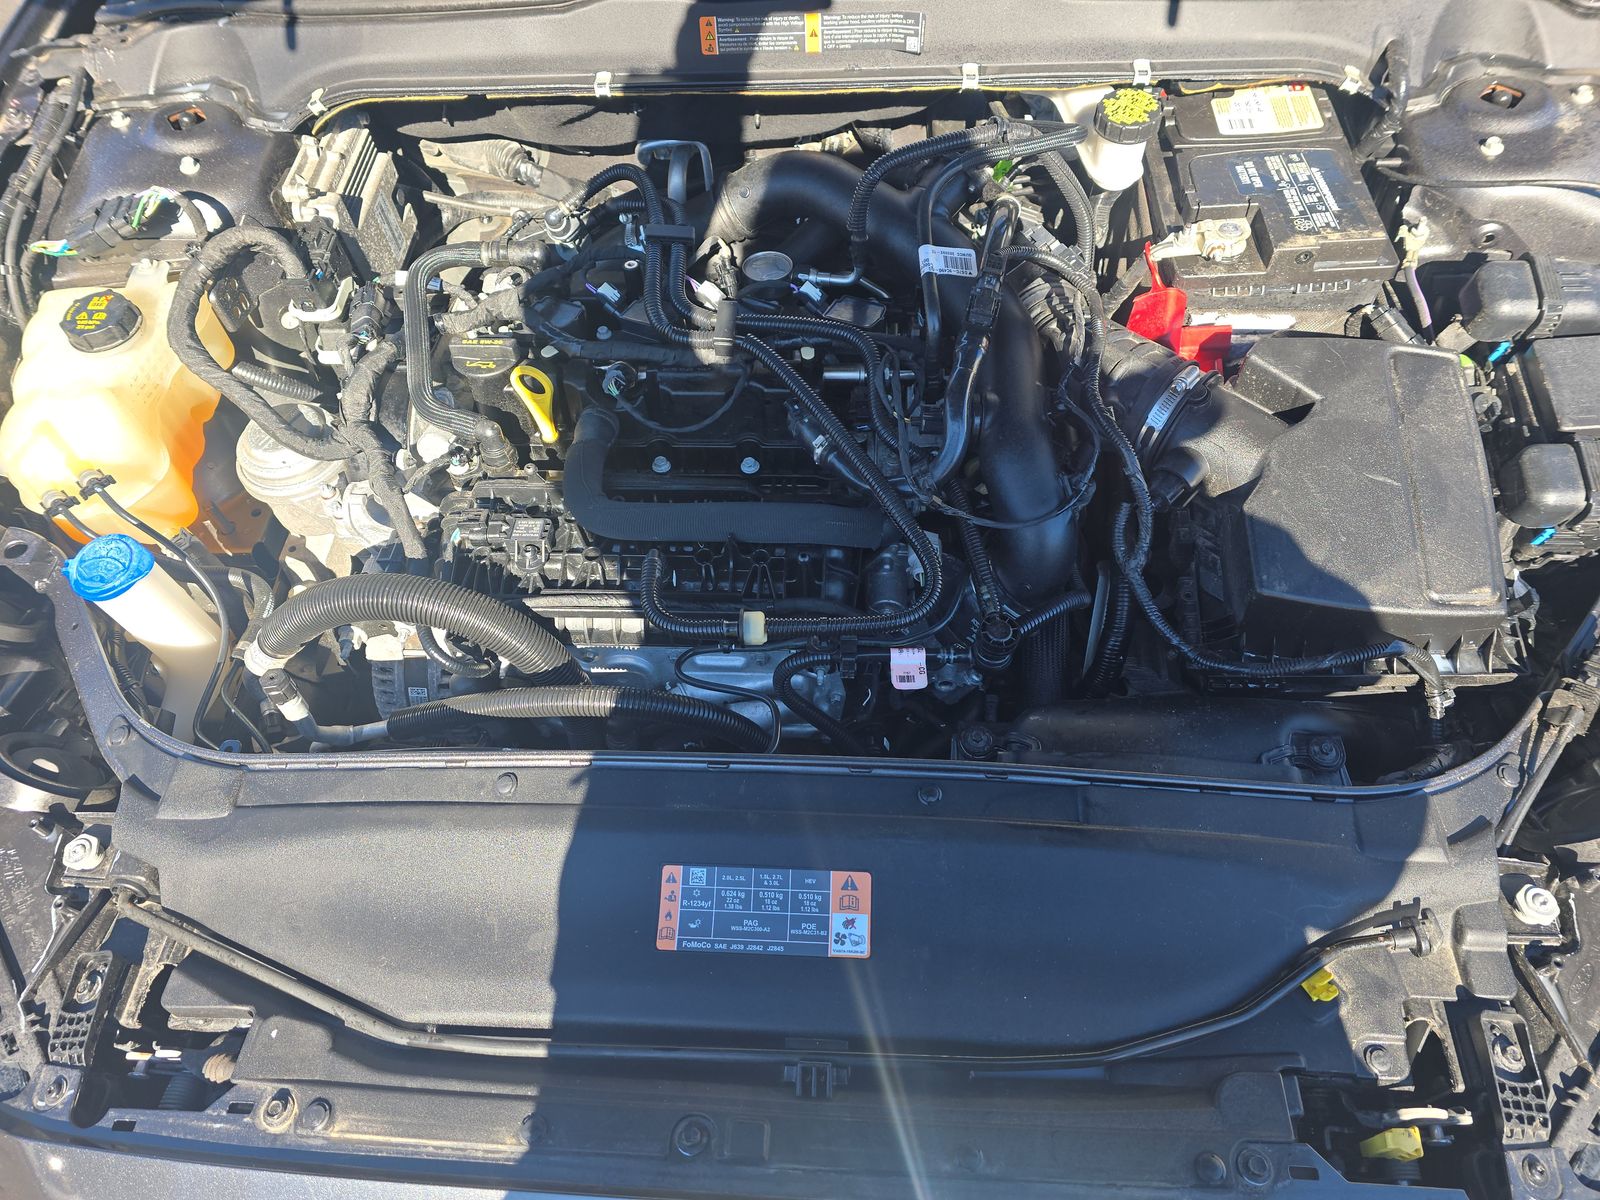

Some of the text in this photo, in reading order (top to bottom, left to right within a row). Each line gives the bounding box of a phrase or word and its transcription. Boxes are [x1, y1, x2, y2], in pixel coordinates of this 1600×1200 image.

[738, 890, 746, 898] kg
[776, 891, 784, 900] kg
[814, 893, 822, 902] kg
[682, 900, 712, 908] R-1234yf
[682, 940, 712, 949] FoMoCo
